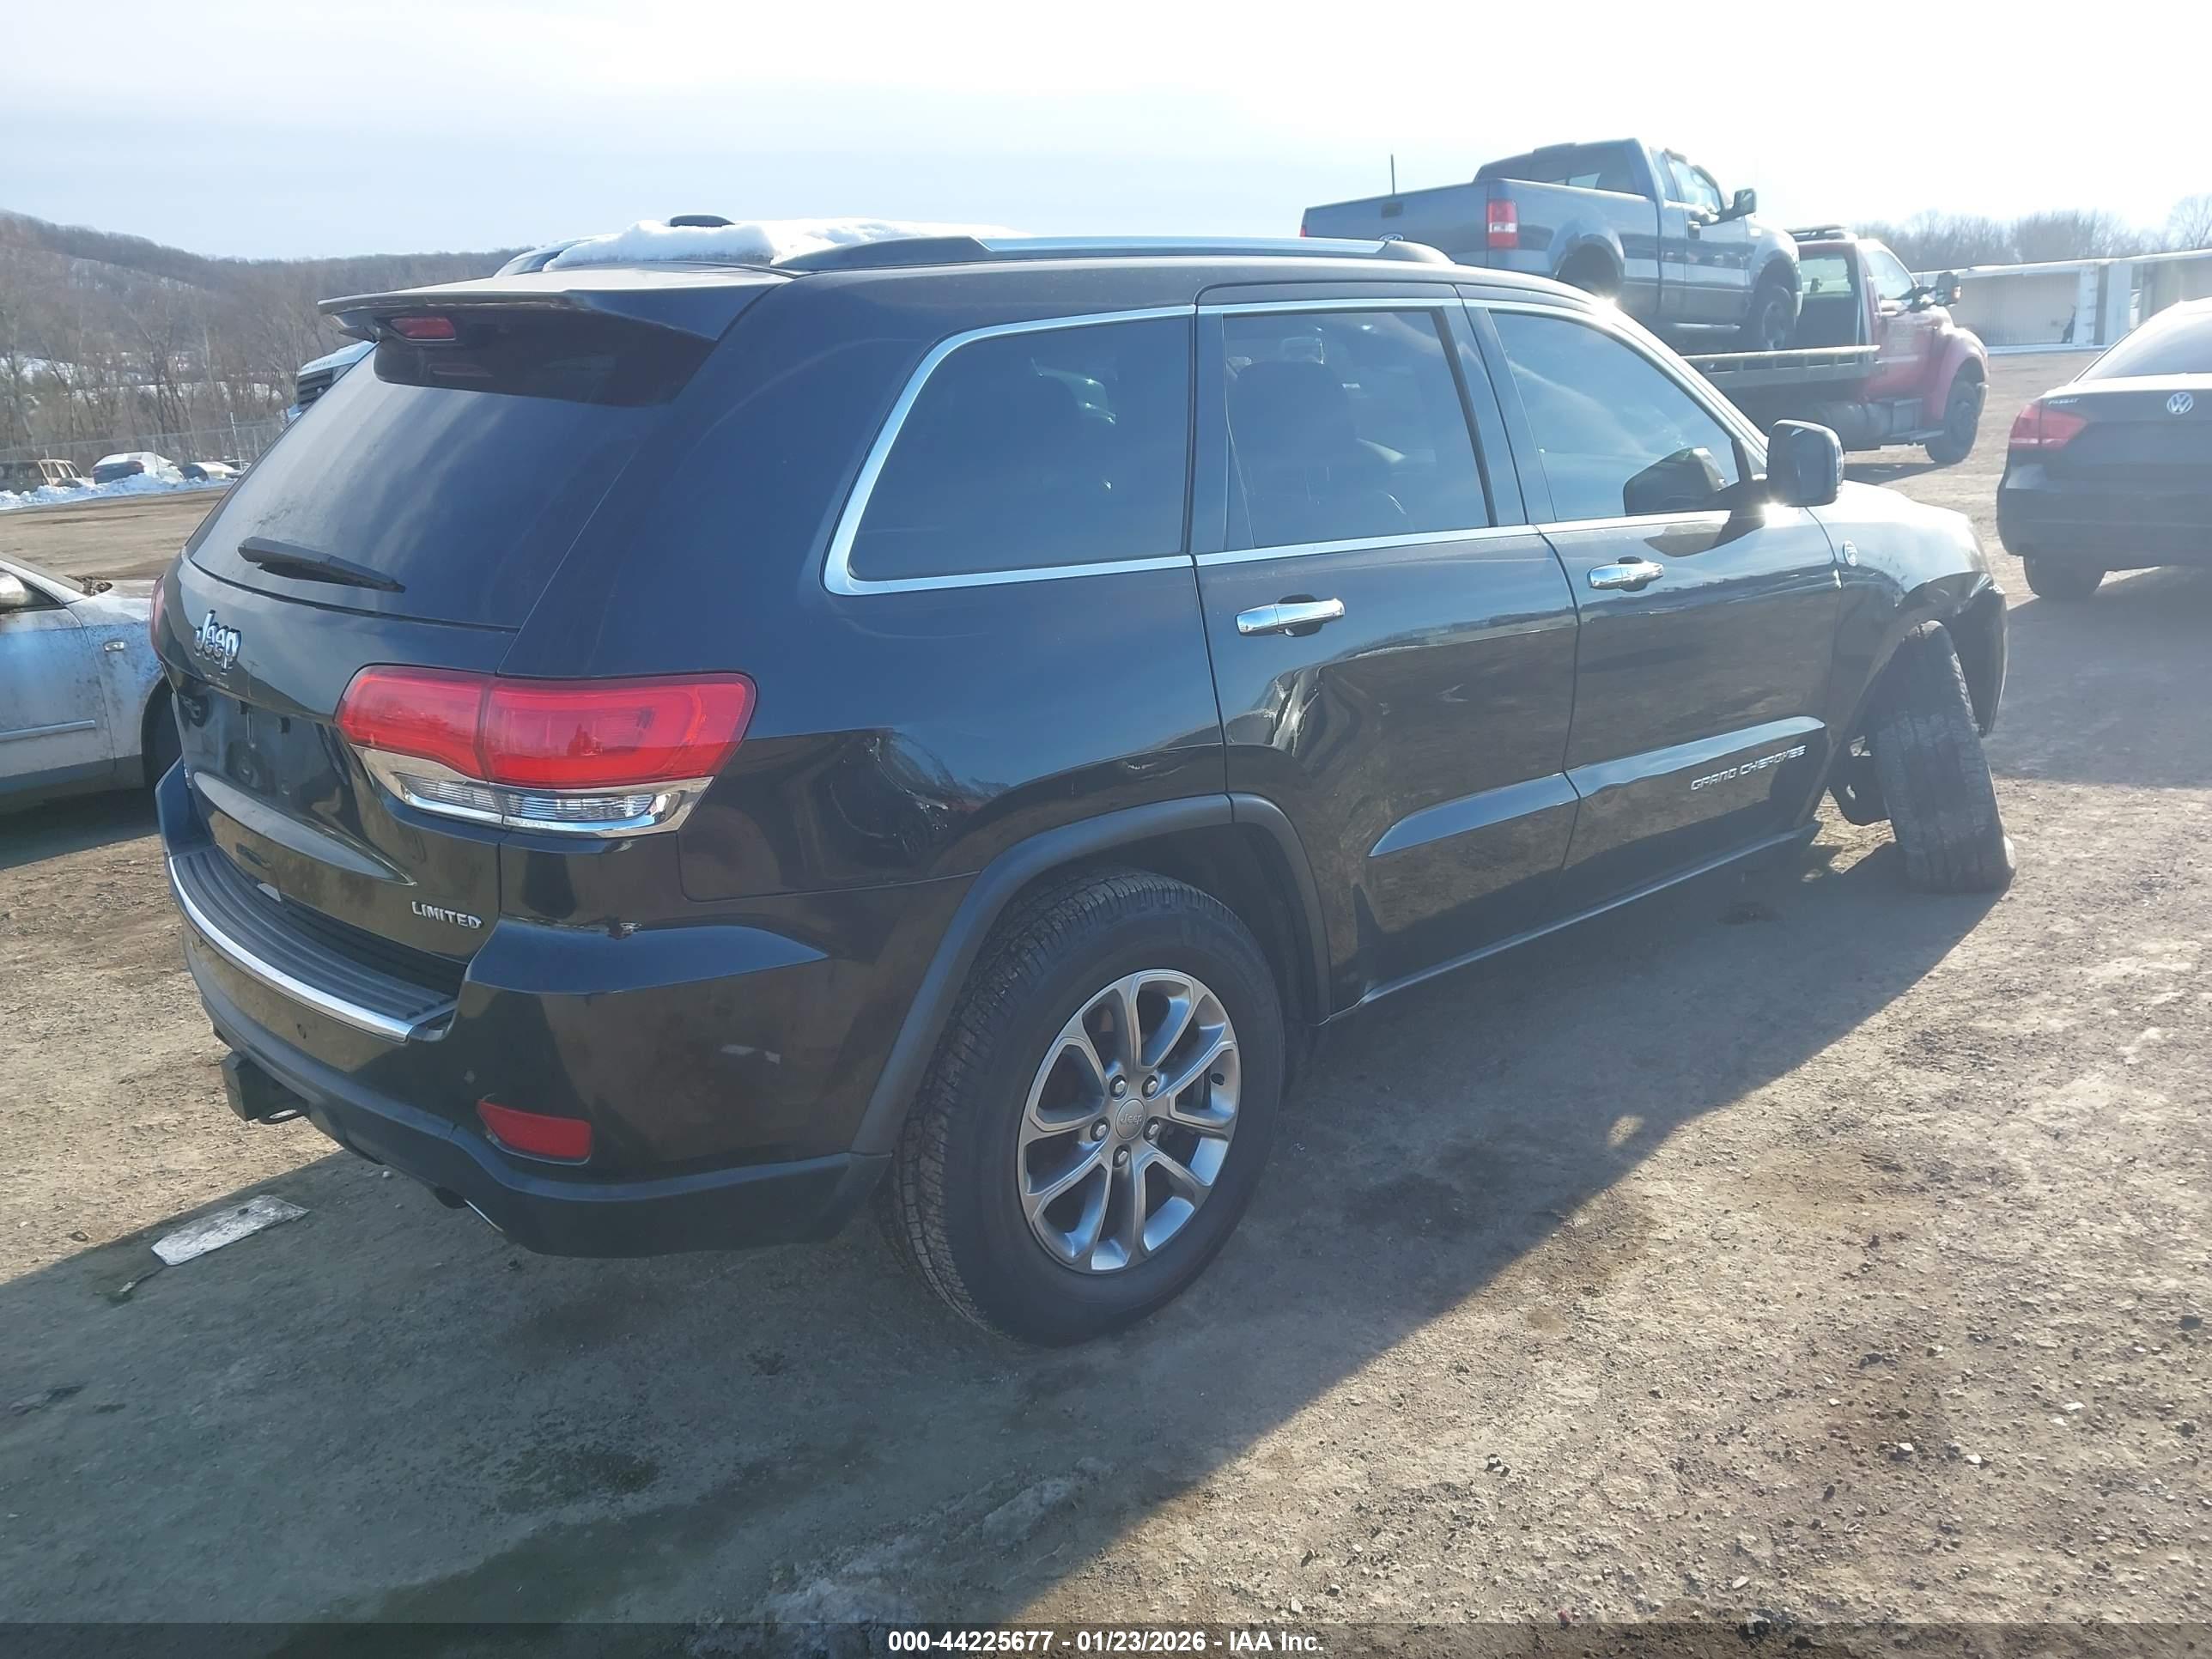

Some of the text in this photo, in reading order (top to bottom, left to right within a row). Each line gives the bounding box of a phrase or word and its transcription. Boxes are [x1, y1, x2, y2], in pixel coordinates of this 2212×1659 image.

[194, 609, 241, 671] Jeep
[1691, 744, 1807, 791] GRAND CHEROKEE
[411, 900, 483, 929] LIMITED
